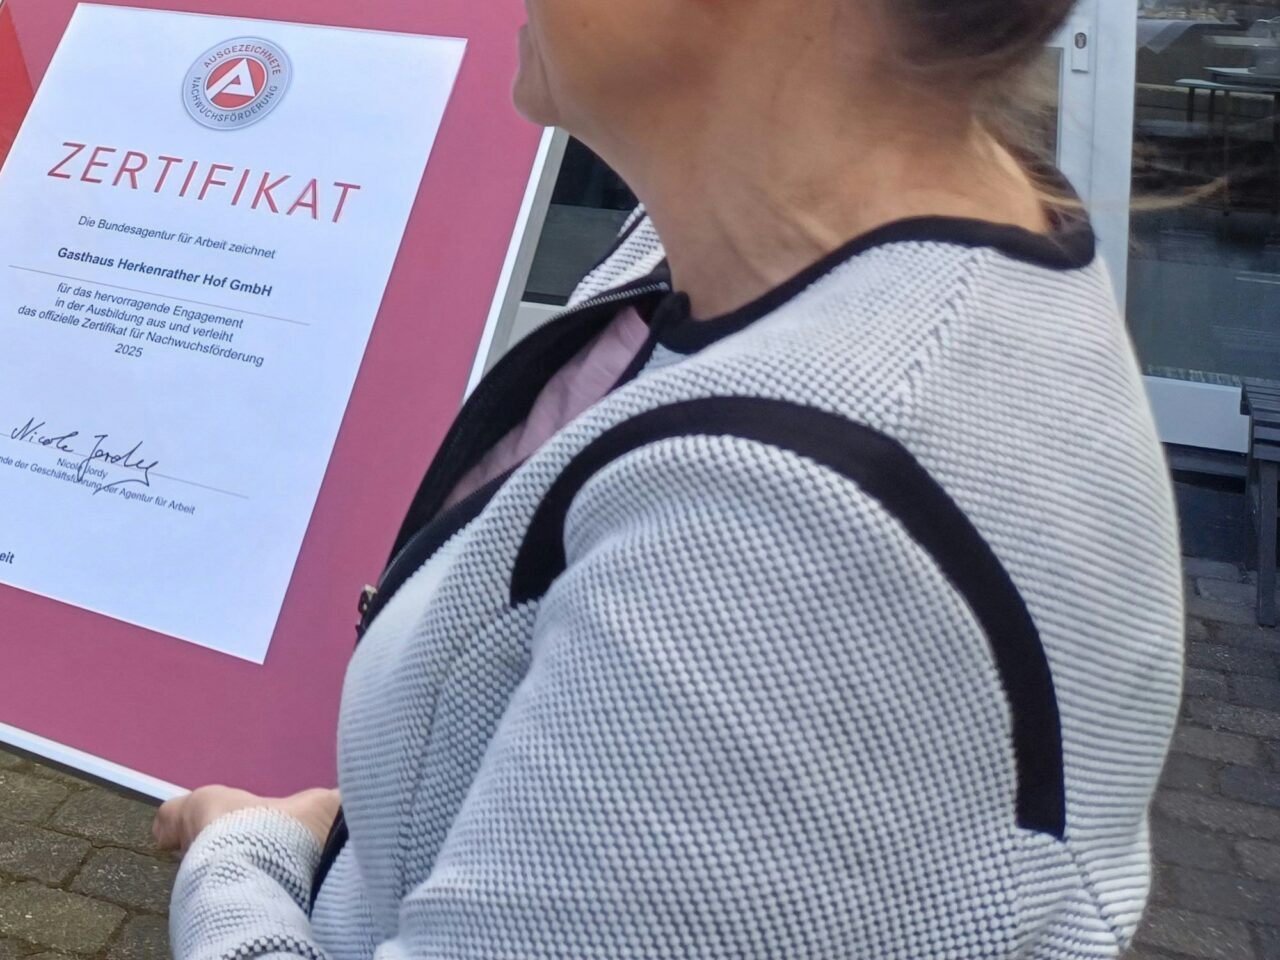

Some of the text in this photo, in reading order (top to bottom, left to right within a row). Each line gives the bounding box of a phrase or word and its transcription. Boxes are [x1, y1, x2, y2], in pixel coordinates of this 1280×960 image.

[203, 44, 281, 76] AUSGEZEICHNETE
[191, 76, 278, 122] NACHWUCHSFÖRDERUNG
[47, 141, 361, 224] ZERTIFIKAT
[78, 215, 277, 259] Die Bundesagentur für Arbeit zeichnet
[57, 247, 273, 297] Gasthaus Herkenrather Hof GmbH
[55, 297, 234, 343] in der Ausbildung aus und verleiht
[56, 282, 244, 329] für das hervorragende Engagement
[18, 305, 264, 368] das offizielle Zertifikat für Nachwuchsförderung
[114, 343, 143, 358] 2025
[11, 417, 78, 453] Nicole
[14, 459, 29, 470] der
[30, 463, 102, 490] Geschäftsführung
[103, 483, 118, 495] der
[120, 487, 154, 503] Agentur
[155, 495, 167, 507] für
[168, 500, 195, 515] Arbeit
[57, 457, 108, 480] Nicole Jordy
